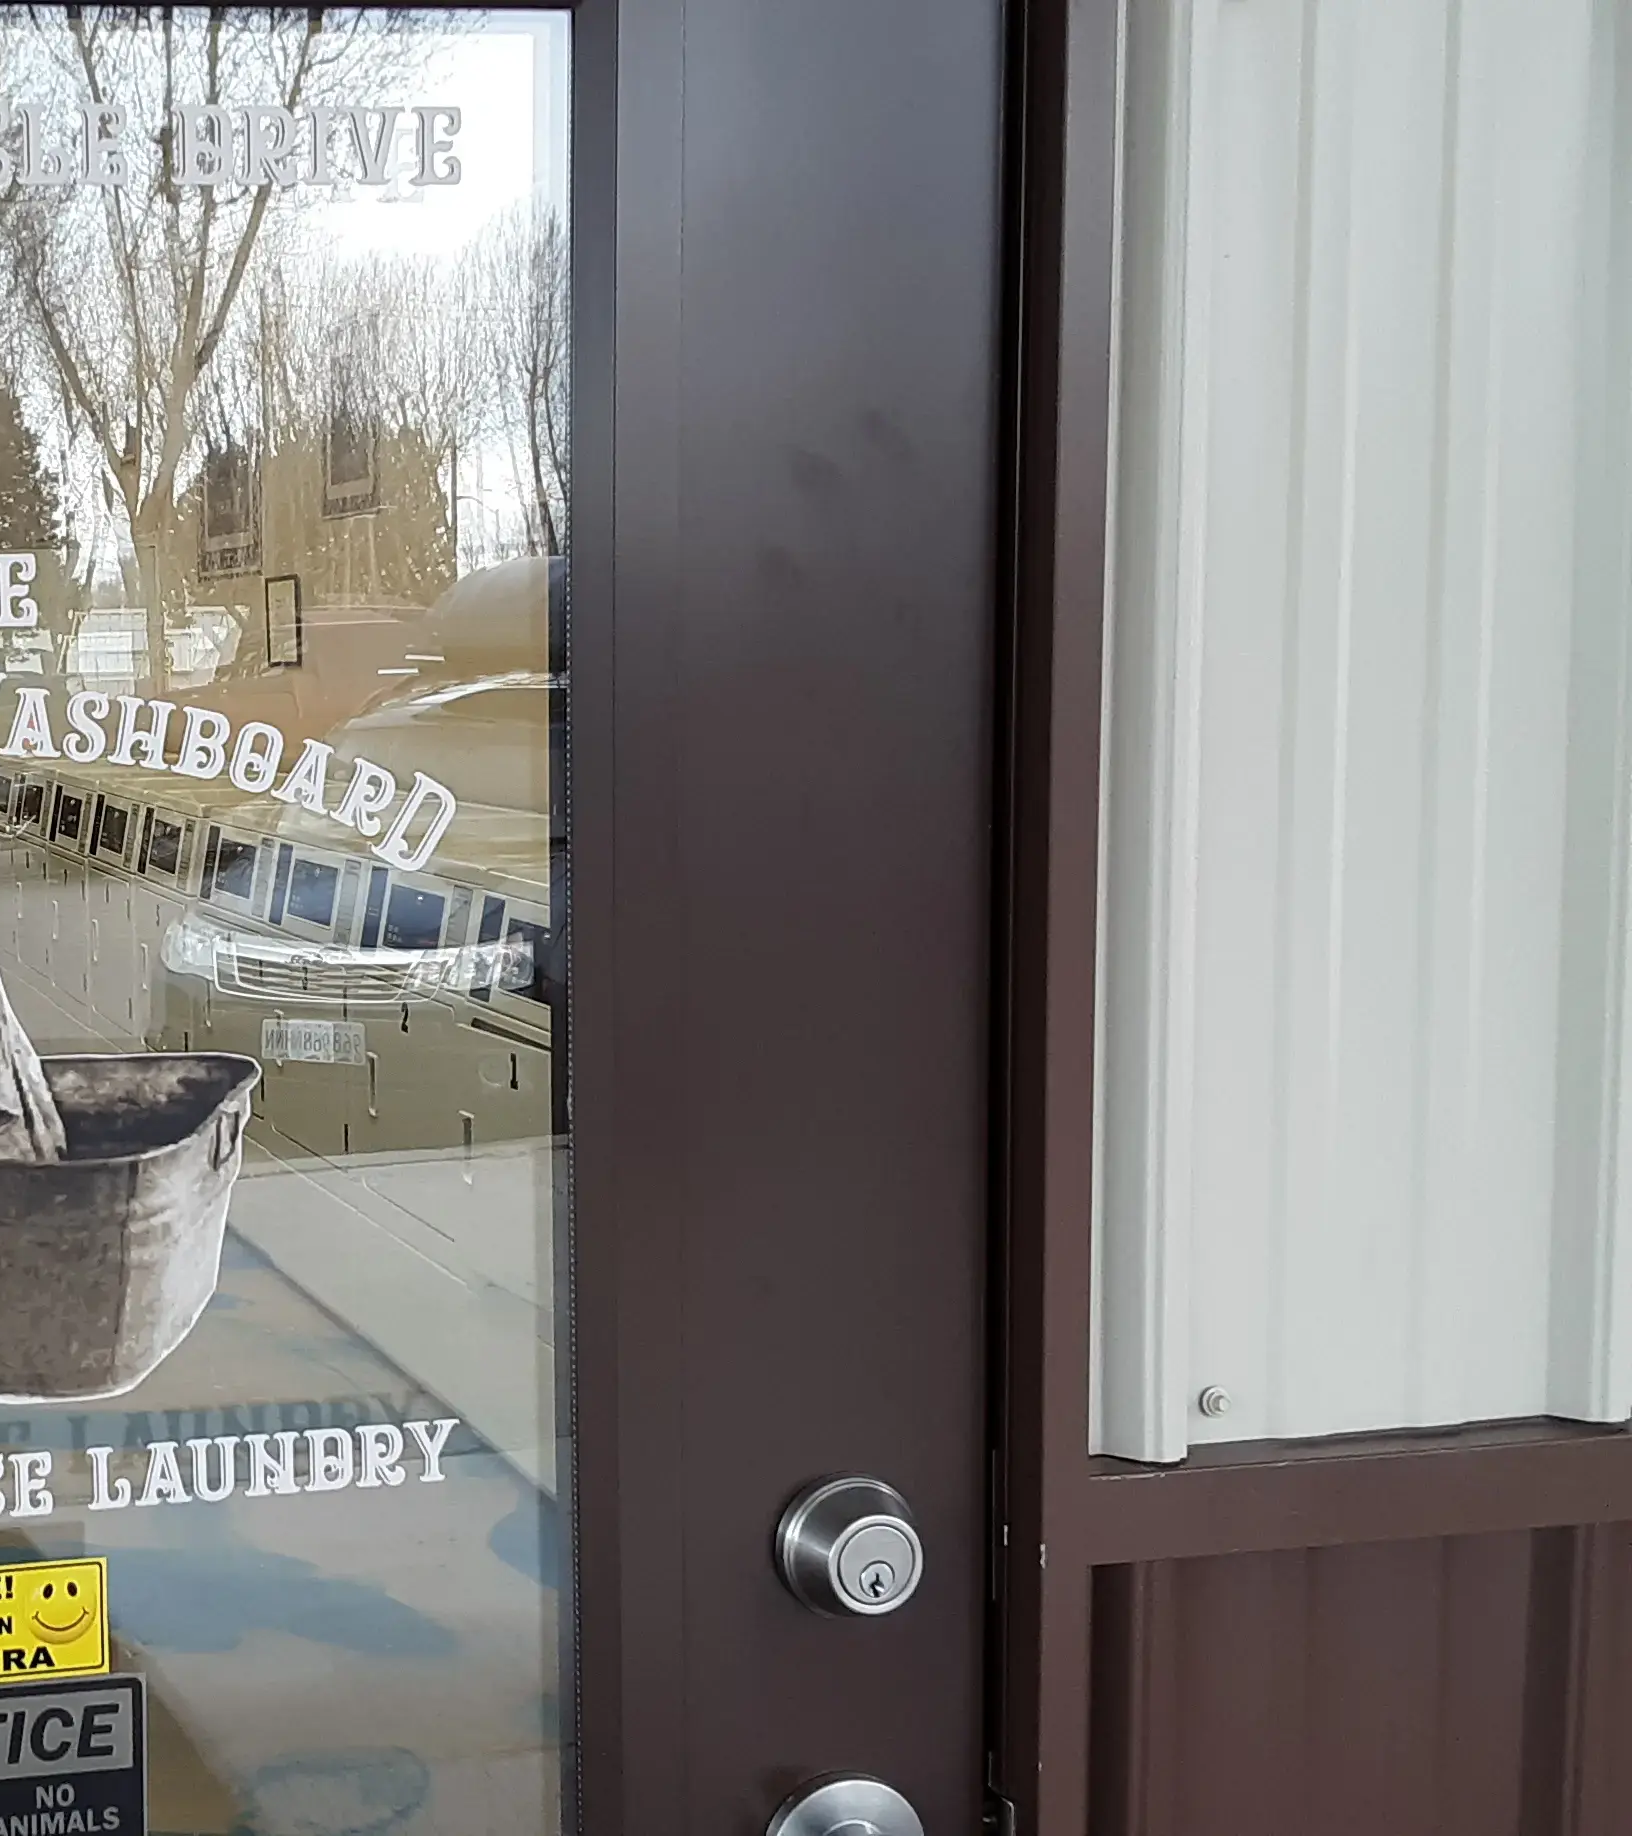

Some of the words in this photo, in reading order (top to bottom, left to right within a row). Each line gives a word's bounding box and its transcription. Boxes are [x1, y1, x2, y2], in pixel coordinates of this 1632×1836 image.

[170, 104, 462, 186] DRIVE
[88, 1417, 461, 1511] LAUNDRY
[35, 1783, 76, 1809] NO
